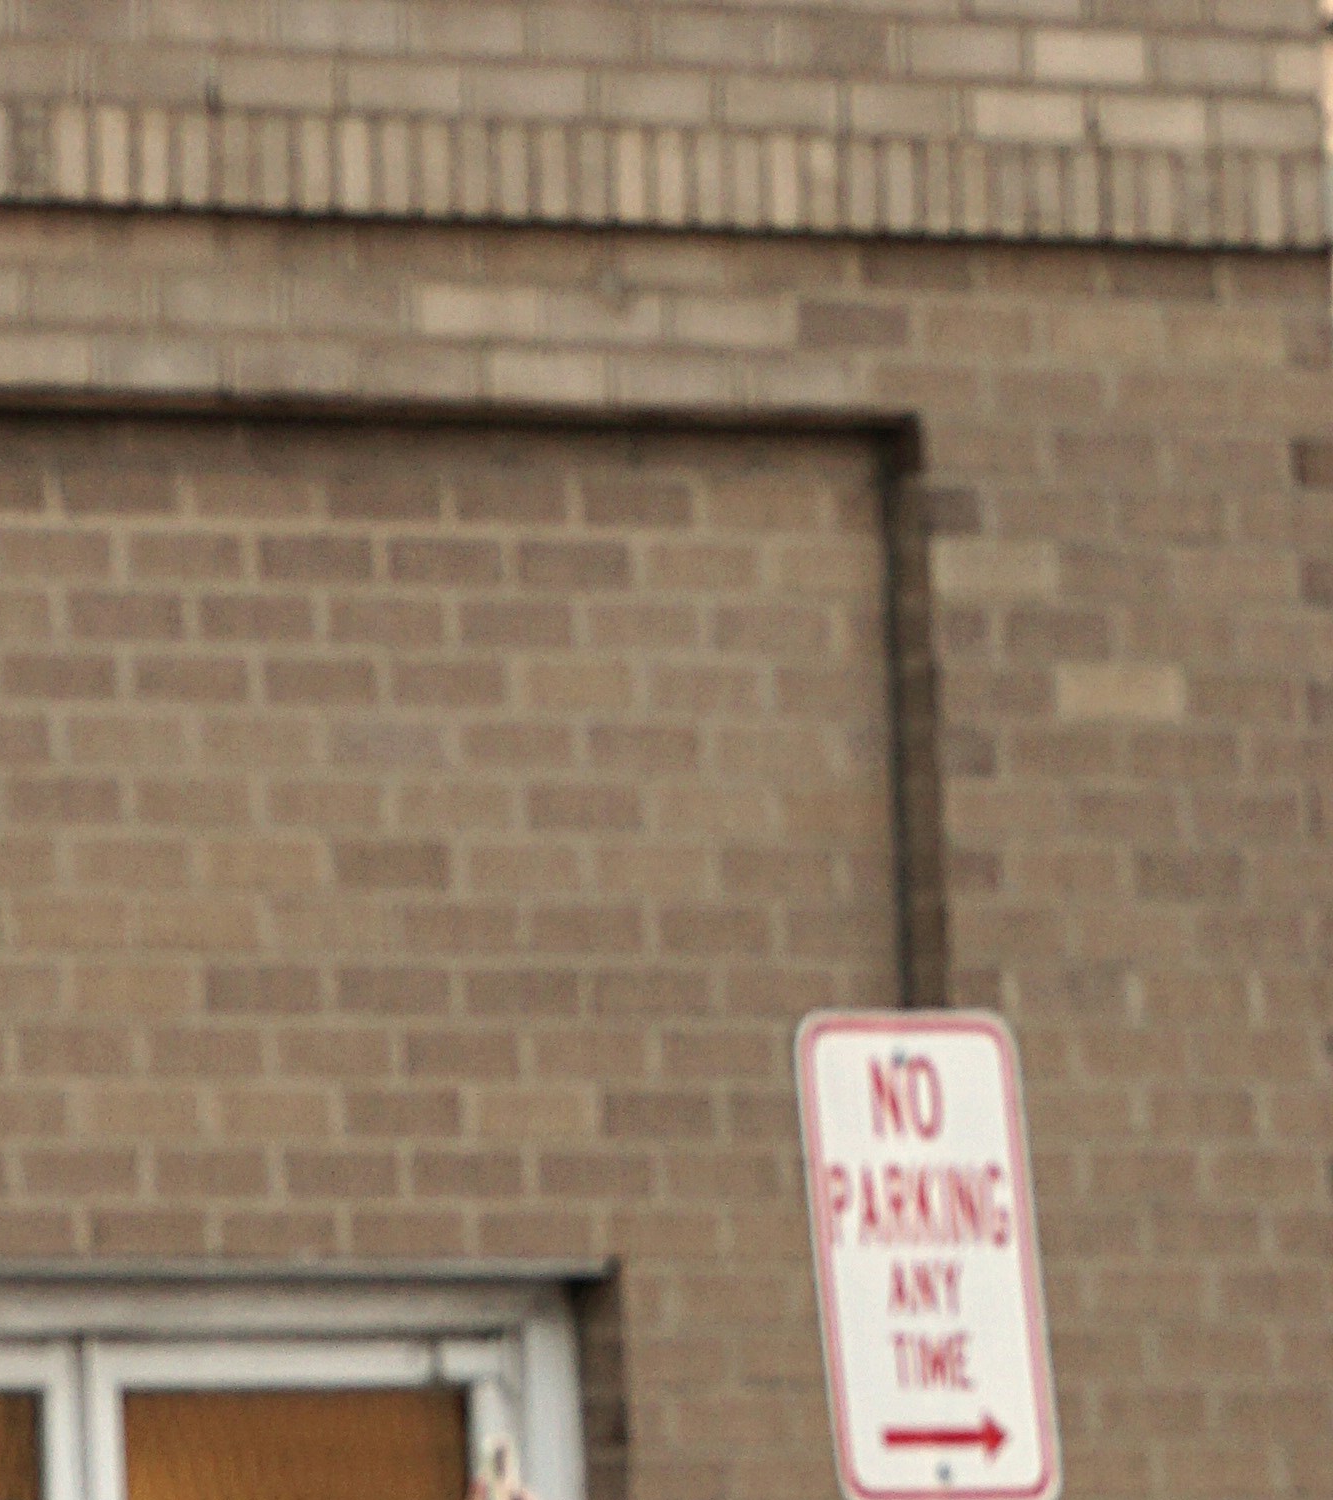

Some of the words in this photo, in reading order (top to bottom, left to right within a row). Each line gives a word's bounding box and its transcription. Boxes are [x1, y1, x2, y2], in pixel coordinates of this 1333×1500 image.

[869, 1054, 946, 1142] NO
[827, 1161, 1012, 1248] PARKING
[889, 1260, 962, 1317] ANY
[891, 1331, 975, 1392] TIME
